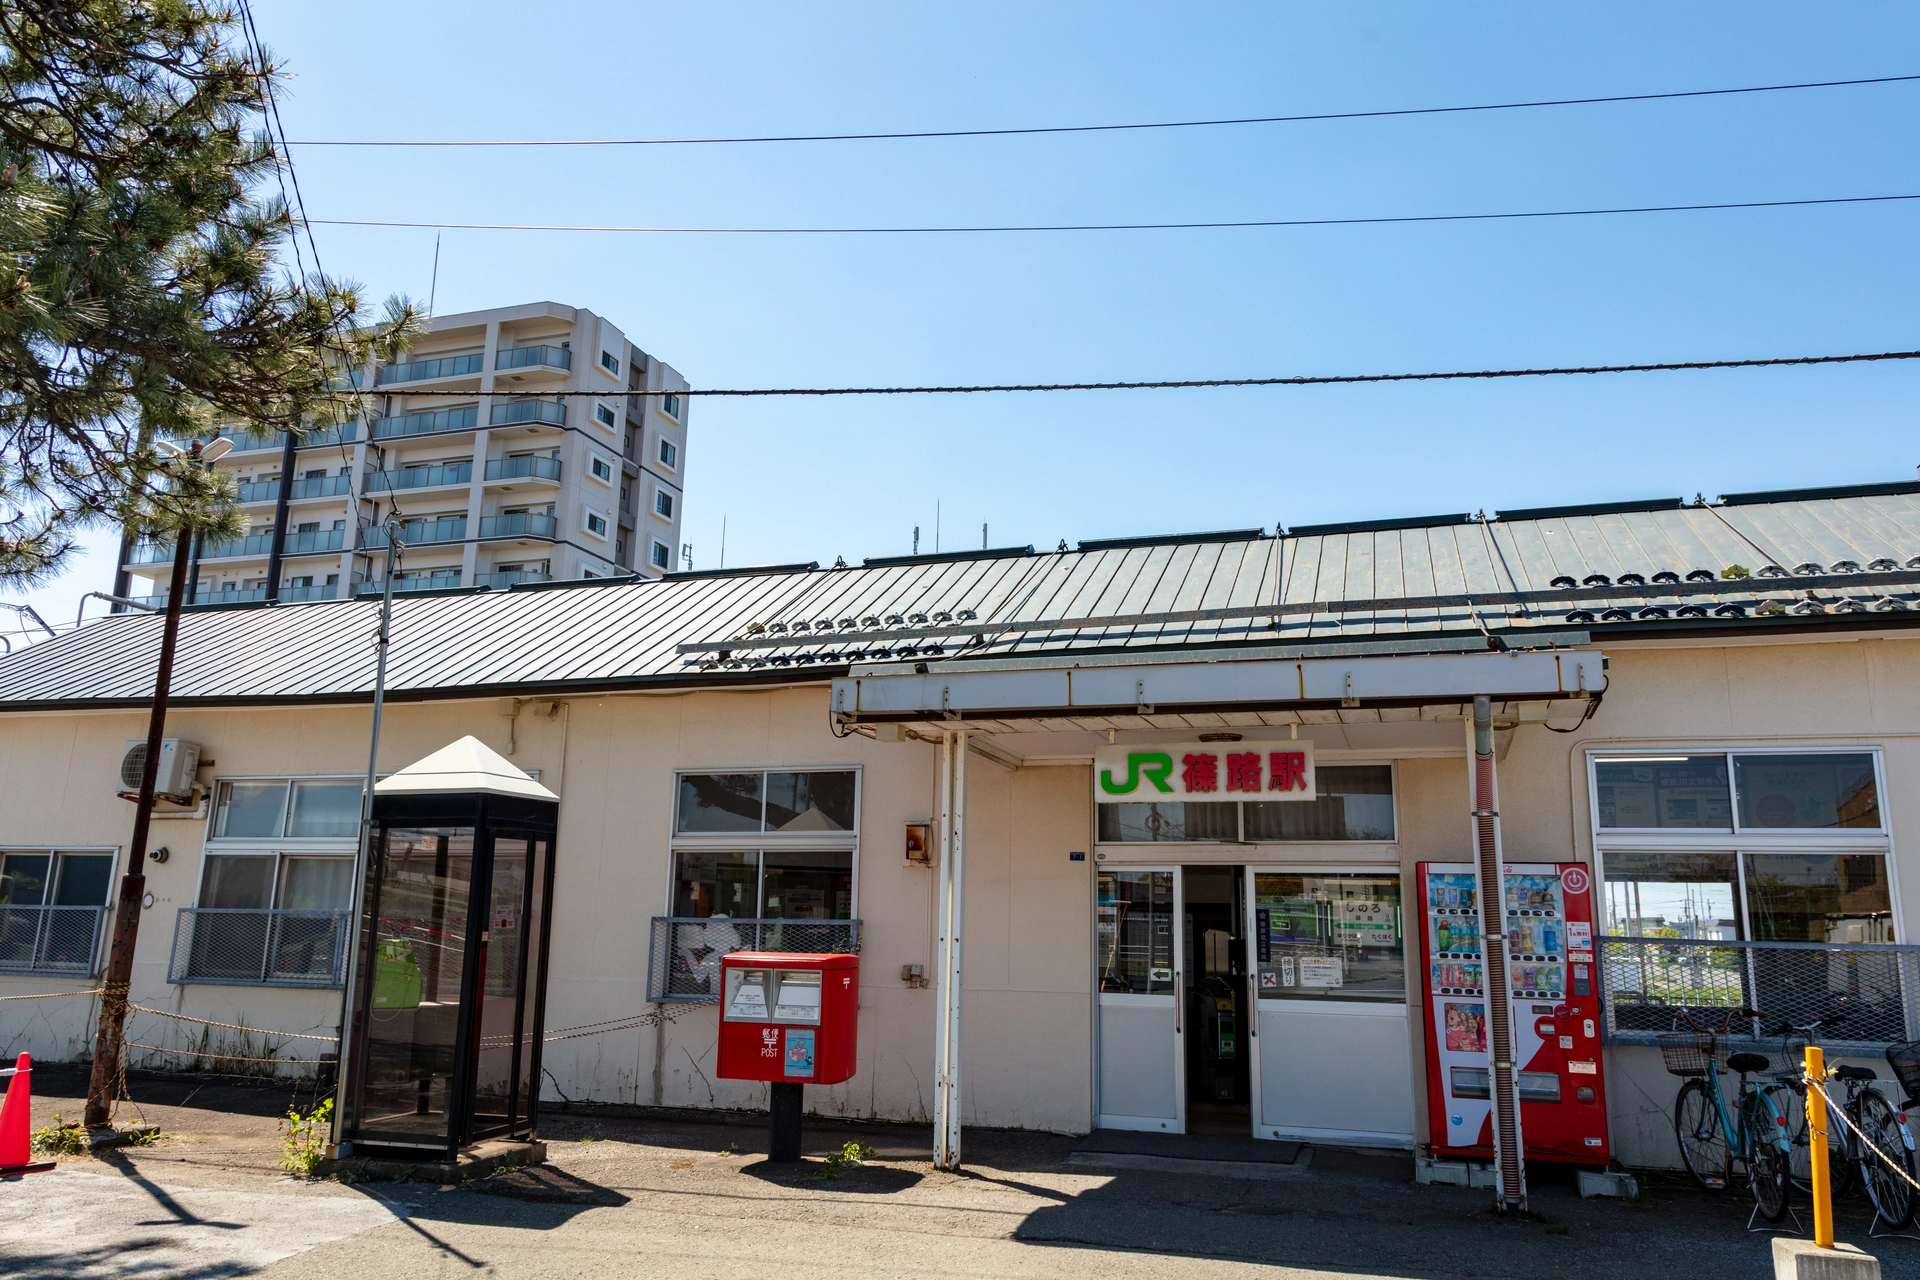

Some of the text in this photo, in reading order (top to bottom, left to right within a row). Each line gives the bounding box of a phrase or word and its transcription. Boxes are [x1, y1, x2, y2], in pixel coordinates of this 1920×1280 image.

[1101, 751, 1307, 794] JR 篠路駅
[1346, 903, 1381, 913] しのろ
[762, 1027, 779, 1039] 郵便
[761, 1047, 778, 1058] POST
